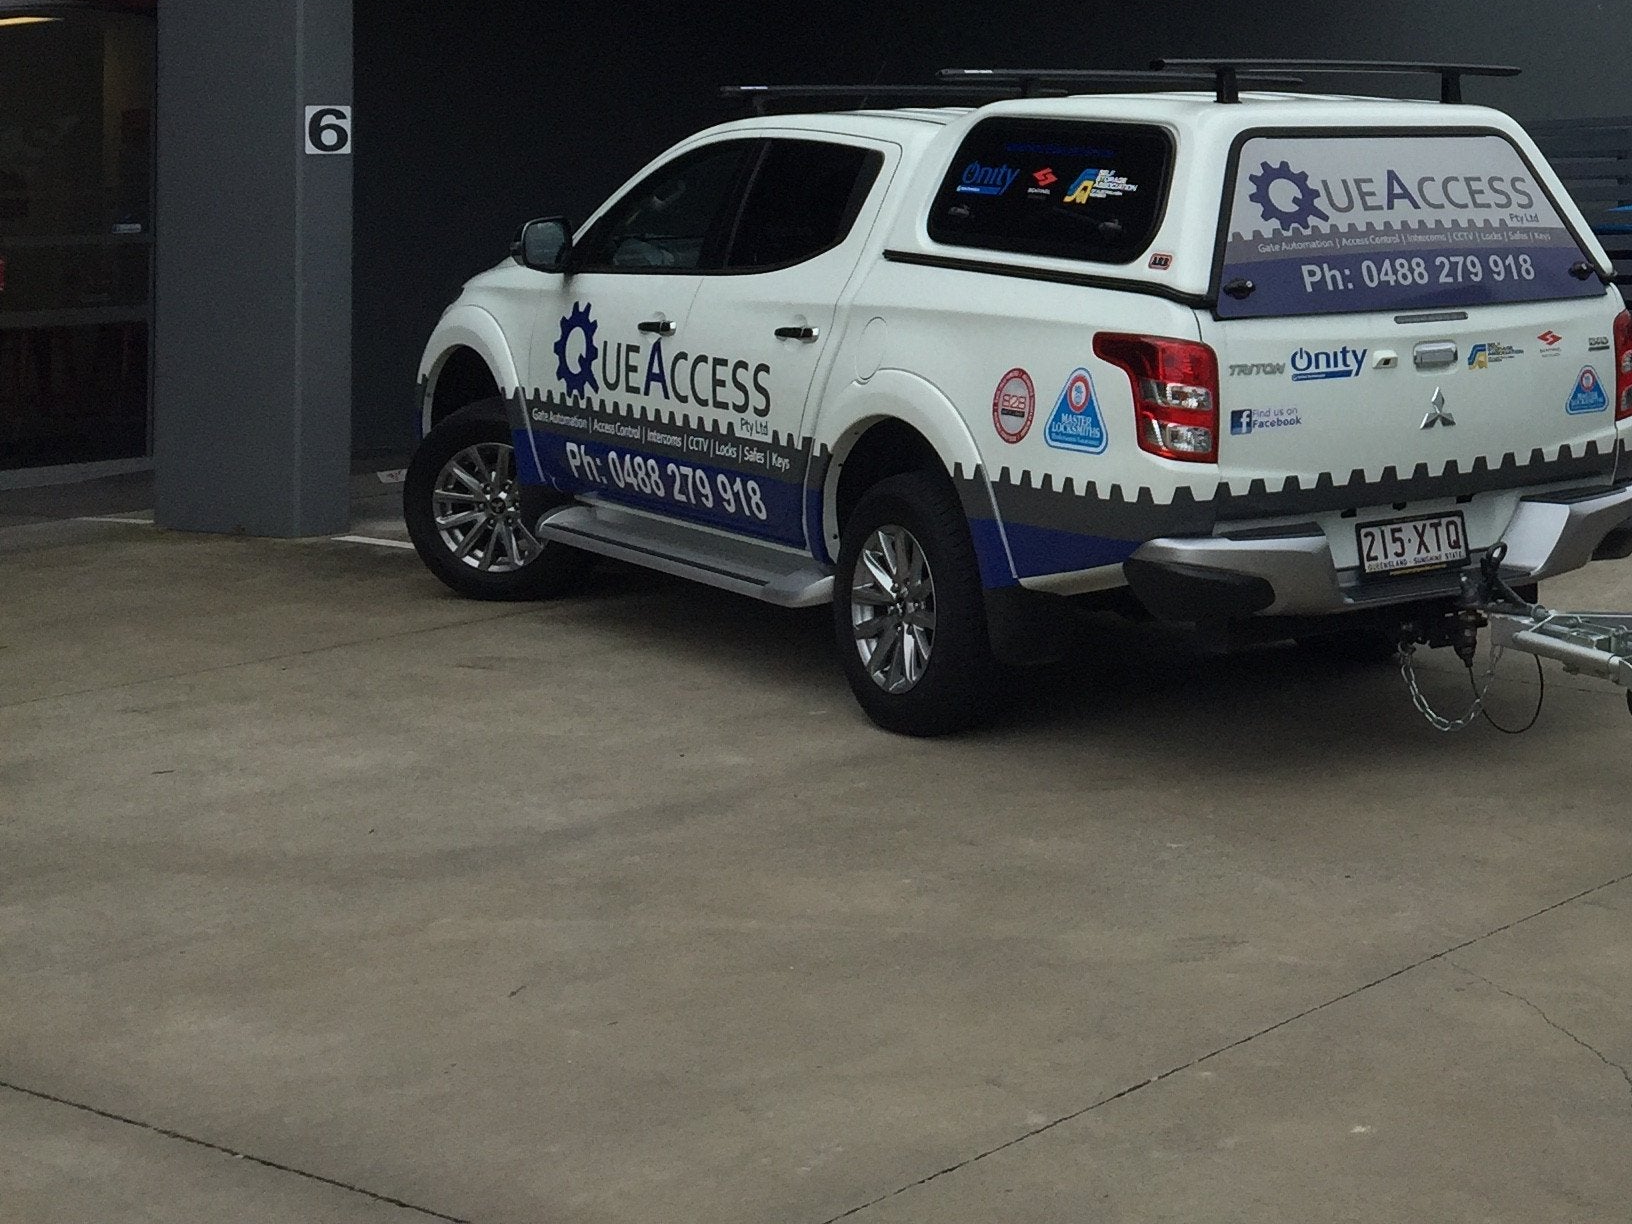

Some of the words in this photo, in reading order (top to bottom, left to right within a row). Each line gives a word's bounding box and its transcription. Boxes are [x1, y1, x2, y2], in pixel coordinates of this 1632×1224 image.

[308, 107, 349, 153] 6
[1258, 242, 1281, 254] Gate
[1281, 239, 1334, 253] Automation
[1342, 236, 1369, 246] Access
[1369, 233, 1399, 245] Control
[1453, 231, 1474, 241] CCTV
[1301, 263, 1353, 293] Ph:
[1361, 257, 1429, 288] 0488
[1435, 254, 1484, 284] 279
[1488, 253, 1535, 281] 918
[1229, 362, 1287, 376] TRITON
[1290, 345, 1368, 377] Onity
[1061, 413, 1092, 426] MASTER
[1252, 409, 1271, 418] Find
[1273, 409, 1284, 417] us
[1286, 407, 1298, 416] on
[1252, 416, 1302, 429] Facebook
[532, 407, 548, 421] Gate
[549, 410, 588, 429] Automation
[592, 418, 615, 435] Access
[615, 422, 641, 439] Control
[647, 427, 682, 448] Intercoms
[688, 435, 709, 453] CCTV
[715, 440, 737, 458] Locks
[743, 446, 765, 464] Safes
[771, 451, 790, 473] Keys
[1051, 421, 1101, 438] LOCKSMITHS
[565, 441, 608, 485] Ph:
[607, 450, 666, 498] 0488
[666, 462, 714, 509] 279
[716, 473, 768, 521] 918
